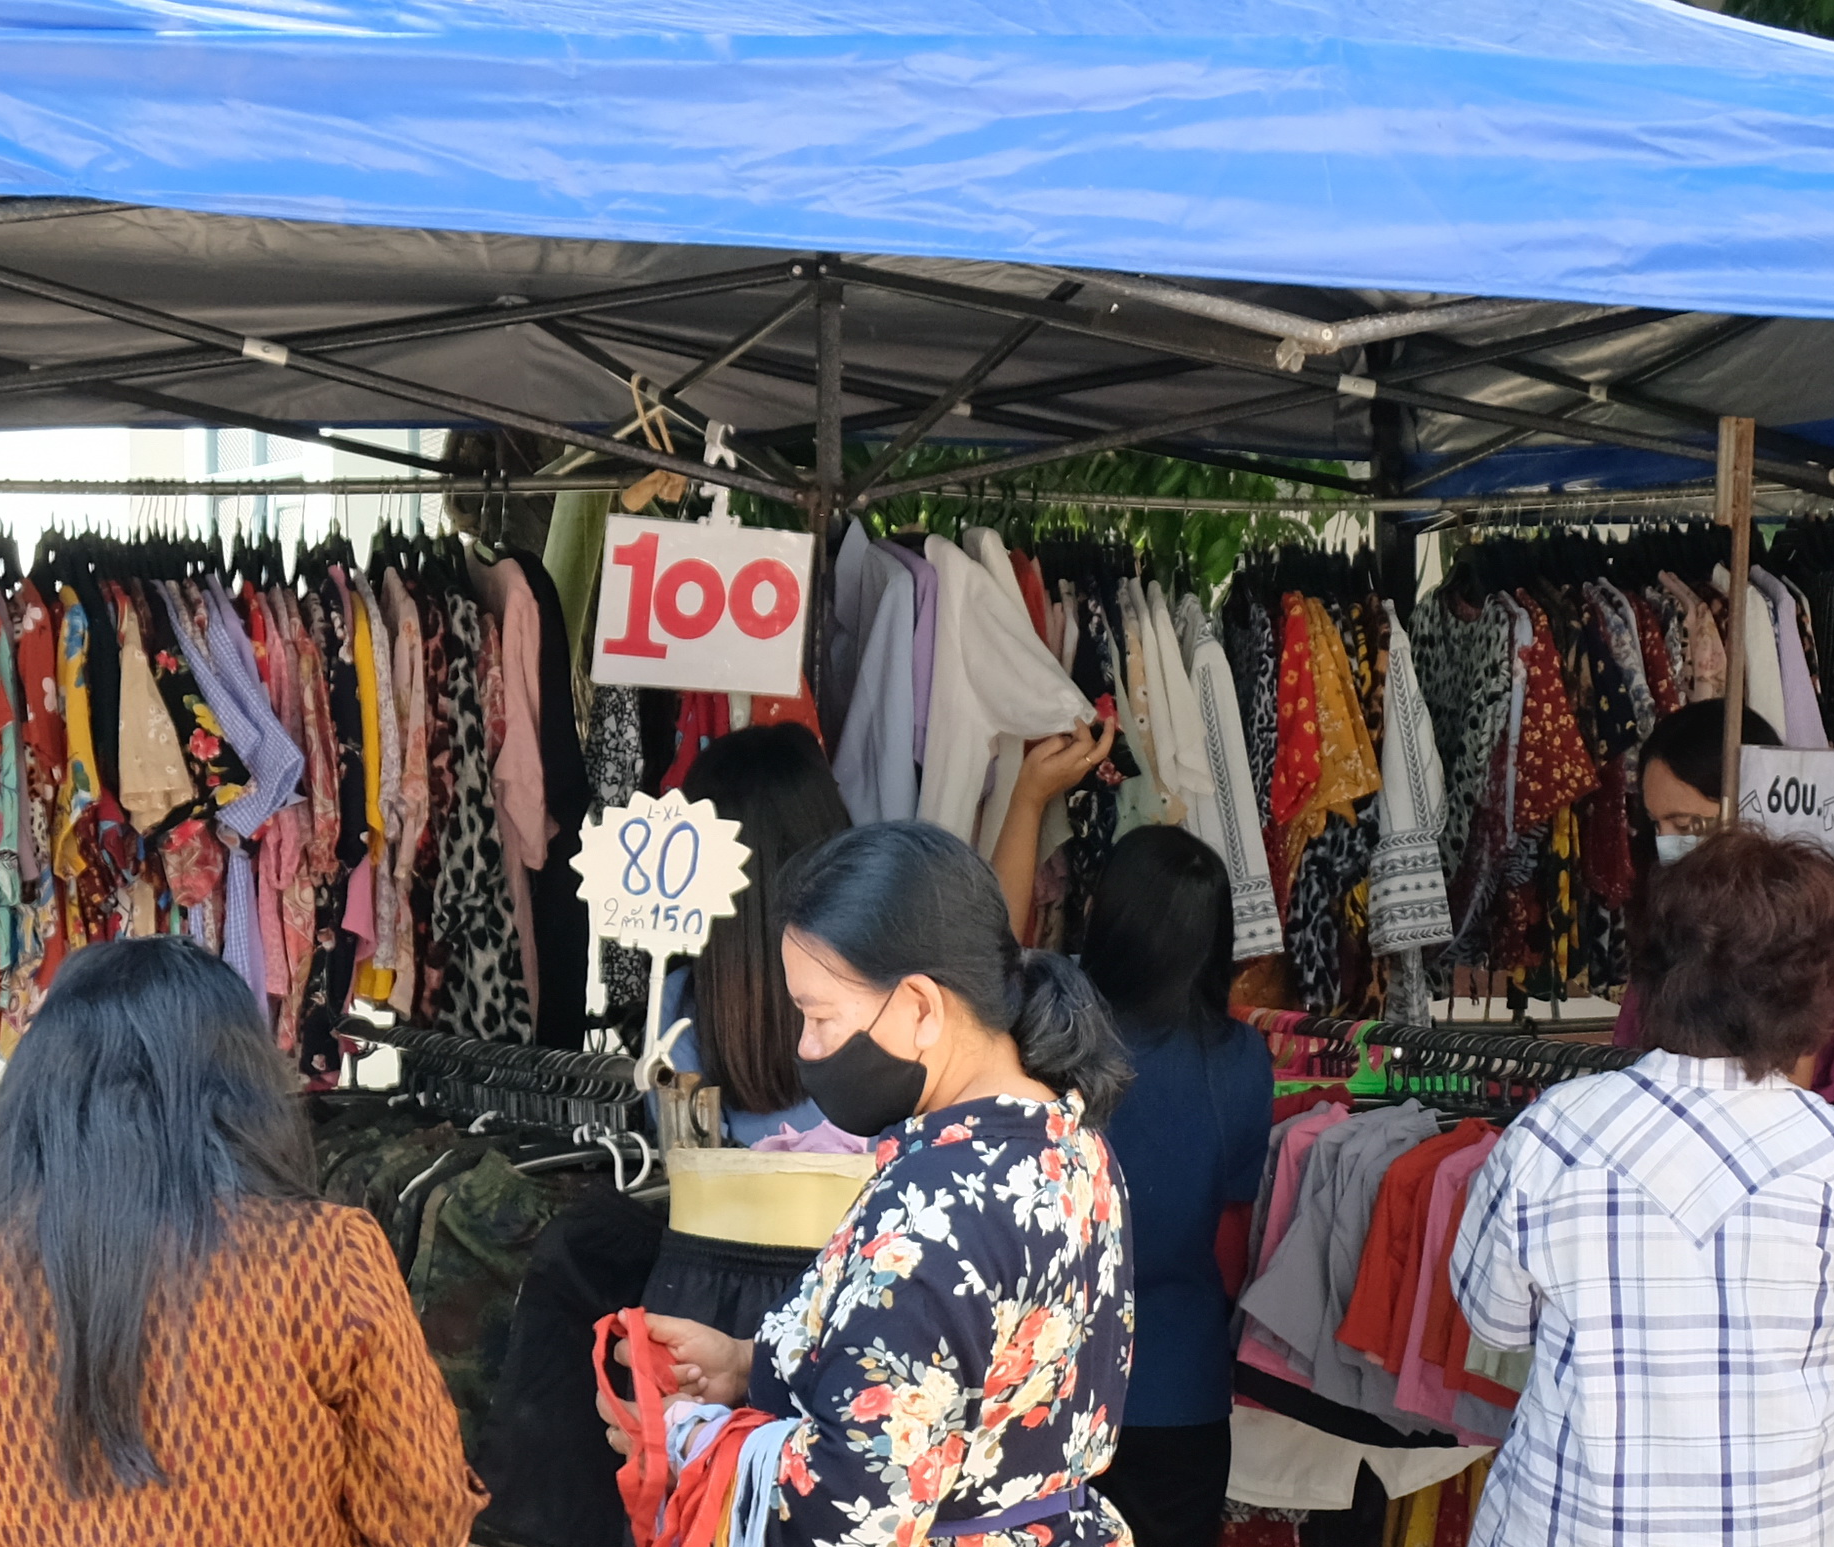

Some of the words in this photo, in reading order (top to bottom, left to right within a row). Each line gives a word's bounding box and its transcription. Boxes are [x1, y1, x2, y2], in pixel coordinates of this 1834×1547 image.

[602, 530, 801, 660] 100
[646, 804, 683, 822] L-XL
[618, 816, 700, 900] 80
[603, 897, 619, 926] 2
